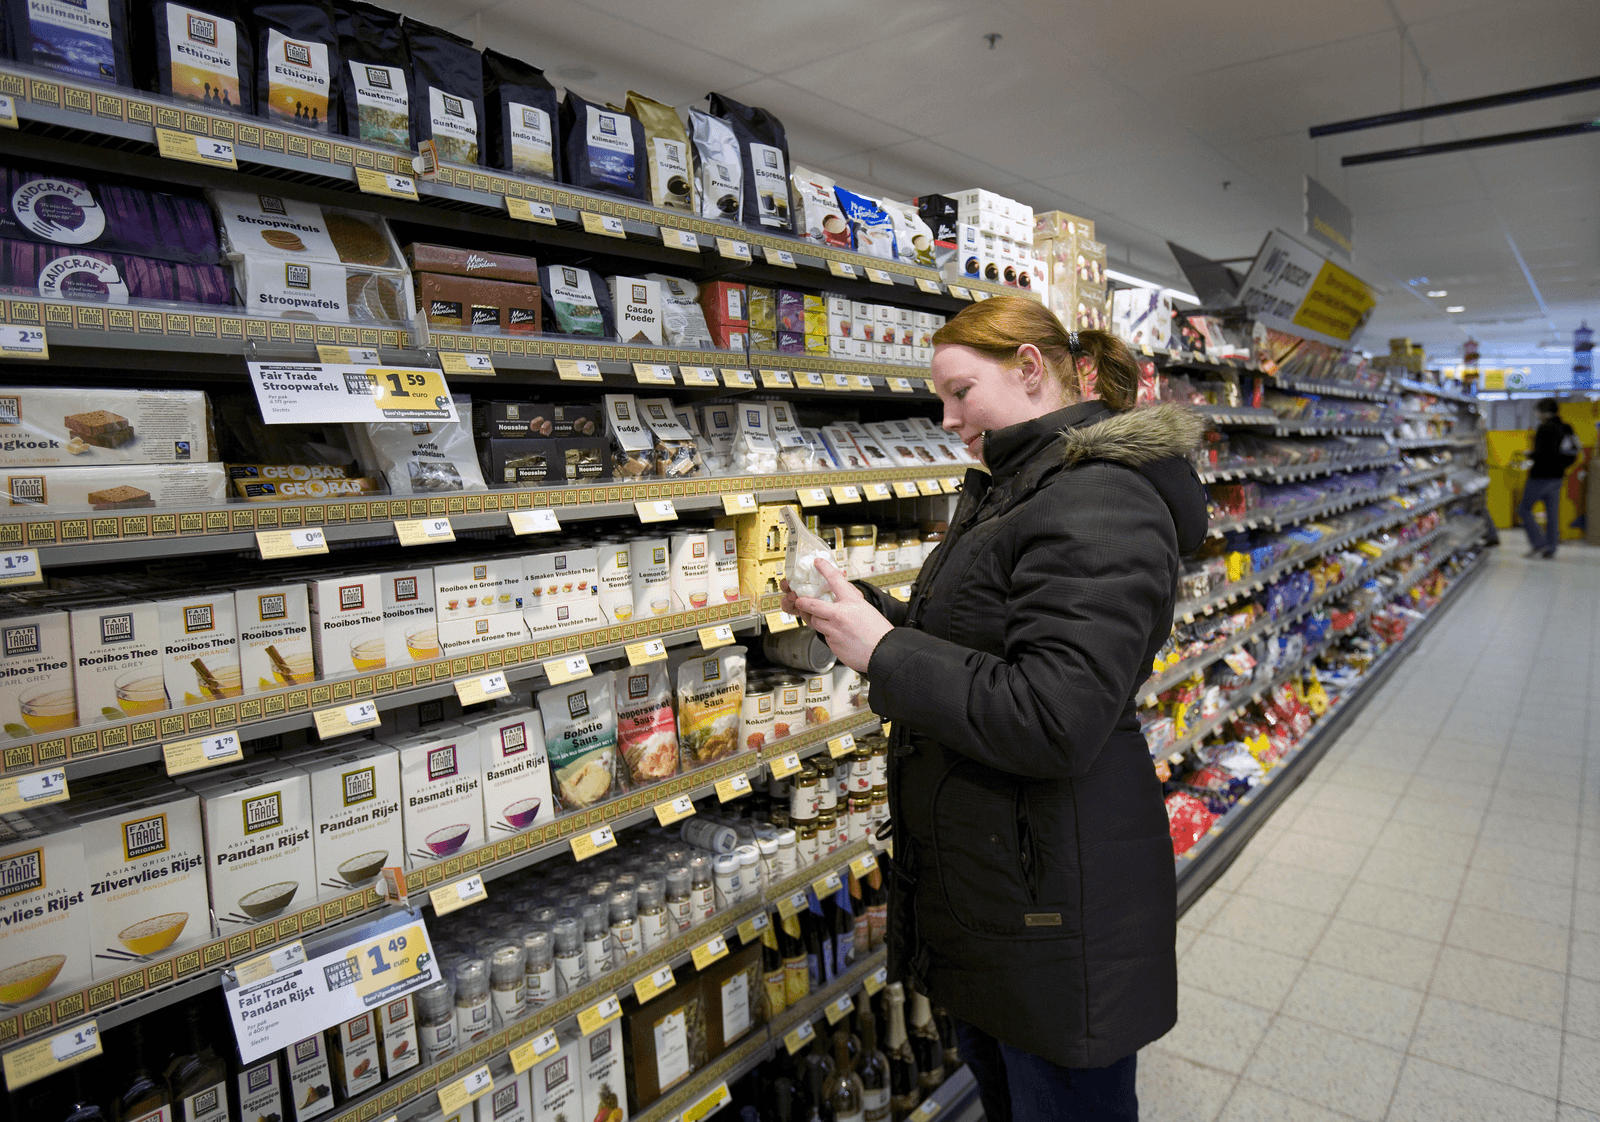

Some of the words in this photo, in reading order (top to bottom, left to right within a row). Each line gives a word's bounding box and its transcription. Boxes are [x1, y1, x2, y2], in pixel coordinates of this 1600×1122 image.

[30, 2, 110, 28] Kilimanjaro
[177, 45, 231, 66] Ethiopië
[275, 66, 325, 85] Ethiopië
[358, 88, 407, 106] Guatemala
[433, 118, 476, 136] Guatemala
[18, 182, 83, 214] TRAIDCRAFT
[237, 214, 320, 234] Stroopwafels
[467, 254, 484, 264] Max
[44, 259, 109, 295] TRAIDCRAFT
[259, 293, 340, 311] Stroopwafels
[626, 304, 653, 315] Cacao
[624, 312, 655, 323] Poeder
[260, 371, 282, 380] Fair
[284, 371, 317, 381] Trade
[263, 382, 339, 393] Stroopwafels
[616, 424, 640, 433] Fudge
[651, 421, 679, 429] Fudge
[0, 439, 60, 451] ngkoek
[519, 469, 547, 477] Noussine
[530, 573, 553, 581] Smaken
[580, 567, 596, 575] Thee
[440, 584, 468, 593] Rooibos
[479, 580, 503, 588] Groene
[415, 606, 434, 615] Thee
[105, 617, 129, 625] FAIR
[189, 612, 210, 624] TRADE
[324, 618, 361, 630] Rooibos
[361, 615, 381, 624] Thee
[8, 628, 33, 636] FAIR
[105, 622, 130, 634] TRADE
[241, 628, 283, 641] Rooibos
[284, 625, 307, 635] Thee
[8, 633, 35, 647] TRADE
[165, 641, 210, 654] Rooibos
[211, 636, 236, 646] Thee
[443, 641, 470, 650] Rooibos
[482, 635, 505, 643] Groene
[79, 653, 129, 667] Rooibos
[130, 648, 158, 658] Thee
[174, 654, 196, 662] SPICY
[199, 648, 230, 657] ORANGE
[0, 667, 35, 678] oibos
[36, 661, 68, 671] Thee
[122, 661, 144, 669] GREY
[27, 674, 52, 683] GREY
[684, 691, 715, 704] Kaapse
[715, 683, 740, 696] Kerrie
[704, 698, 724, 708] Saus
[633, 715, 655, 726] Saus
[563, 722, 603, 740] Bobotie
[572, 734, 598, 748] Saus
[487, 763, 525, 781] Basmati
[526, 755, 545, 770] Rijst
[348, 773, 370, 782] FAIR
[348, 778, 371, 794] TRADE
[409, 787, 453, 807] Basmati
[455, 780, 478, 796] Rijst
[249, 798, 275, 809] FAIR
[250, 804, 276, 822] TRADE
[320, 813, 368, 834] Pandan
[371, 802, 399, 819] Rijst
[129, 820, 160, 832] FAIR
[130, 827, 161, 848] TRADE
[217, 841, 274, 865] Pandan
[278, 829, 310, 848] Rijst
[1, 855, 36, 869] FAIR
[105, 865, 137, 877] ASIAN
[143, 851, 188, 867] ORIGINAL
[1, 862, 37, 885] TRADE
[91, 865, 169, 896] Zilvervlies
[171, 854, 203, 874] Rijst
[47, 891, 84, 912] Rijst
[393, 957, 410, 968] euro
[328, 964, 360, 984] WEEK
[239, 992, 264, 1008] Fair
[266, 980, 297, 999] Trade
[241, 999, 288, 1022] Pandan
[289, 986, 315, 1005] Rijst
[257, 1019, 267, 1027] pak
[265, 1021, 280, 1031] gram
[250, 1034, 270, 1047] Slechts
